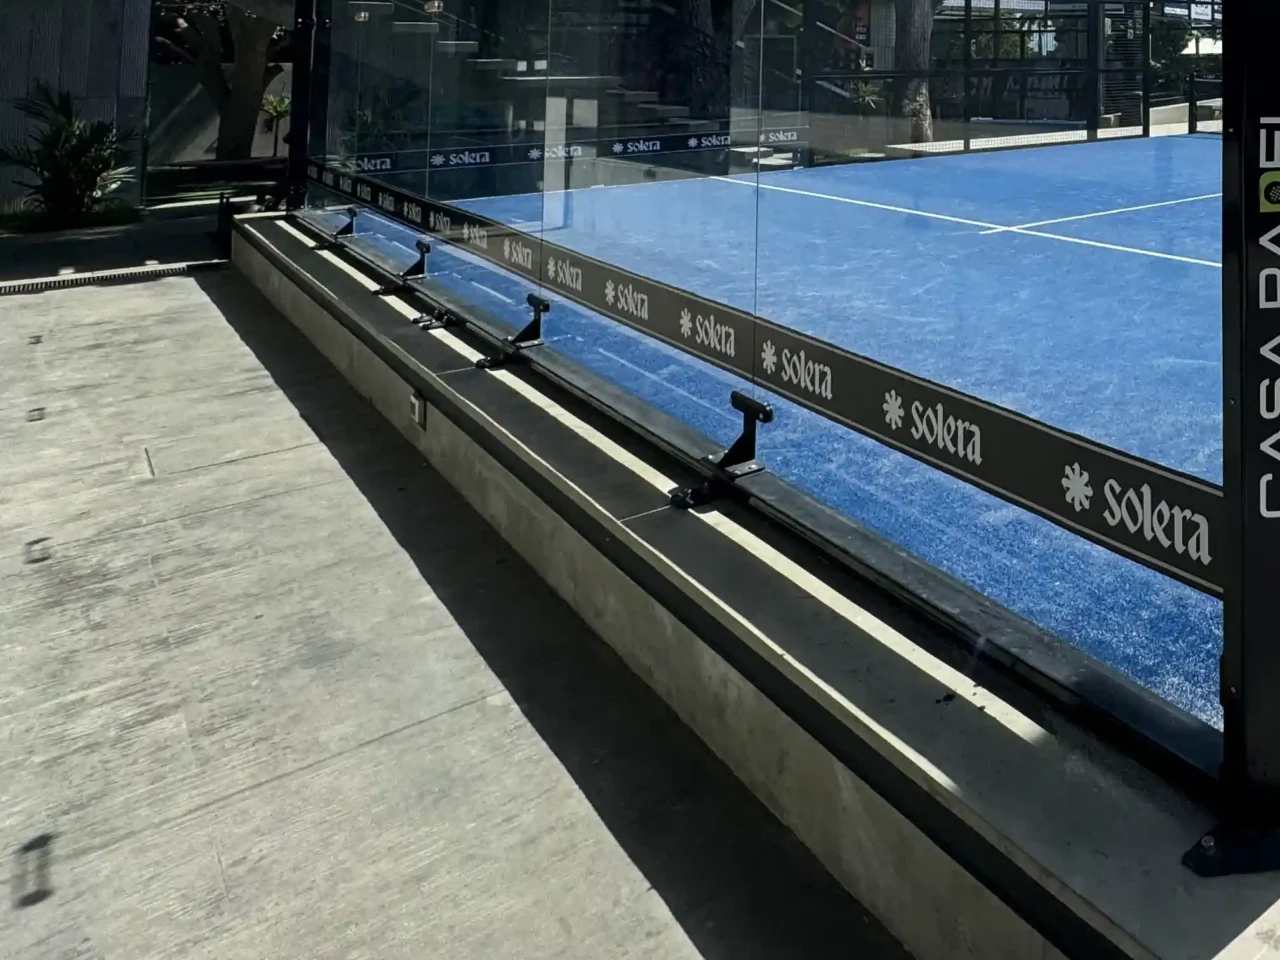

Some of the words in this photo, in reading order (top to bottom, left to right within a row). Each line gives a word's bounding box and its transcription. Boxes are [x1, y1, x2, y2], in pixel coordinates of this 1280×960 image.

[545, 145, 582, 158] solera
[627, 139, 661, 152] solera
[701, 134, 732, 147] solera
[768, 130, 798, 142] solera
[449, 150, 491, 165] solera
[511, 239, 532, 270] solera
[557, 258, 582, 292] solera
[617, 283, 649, 320] solera
[695, 313, 736, 358] solera
[781, 348, 833, 400] solera
[910, 400, 983, 466] solera
[1103, 478, 1213, 566] solera
